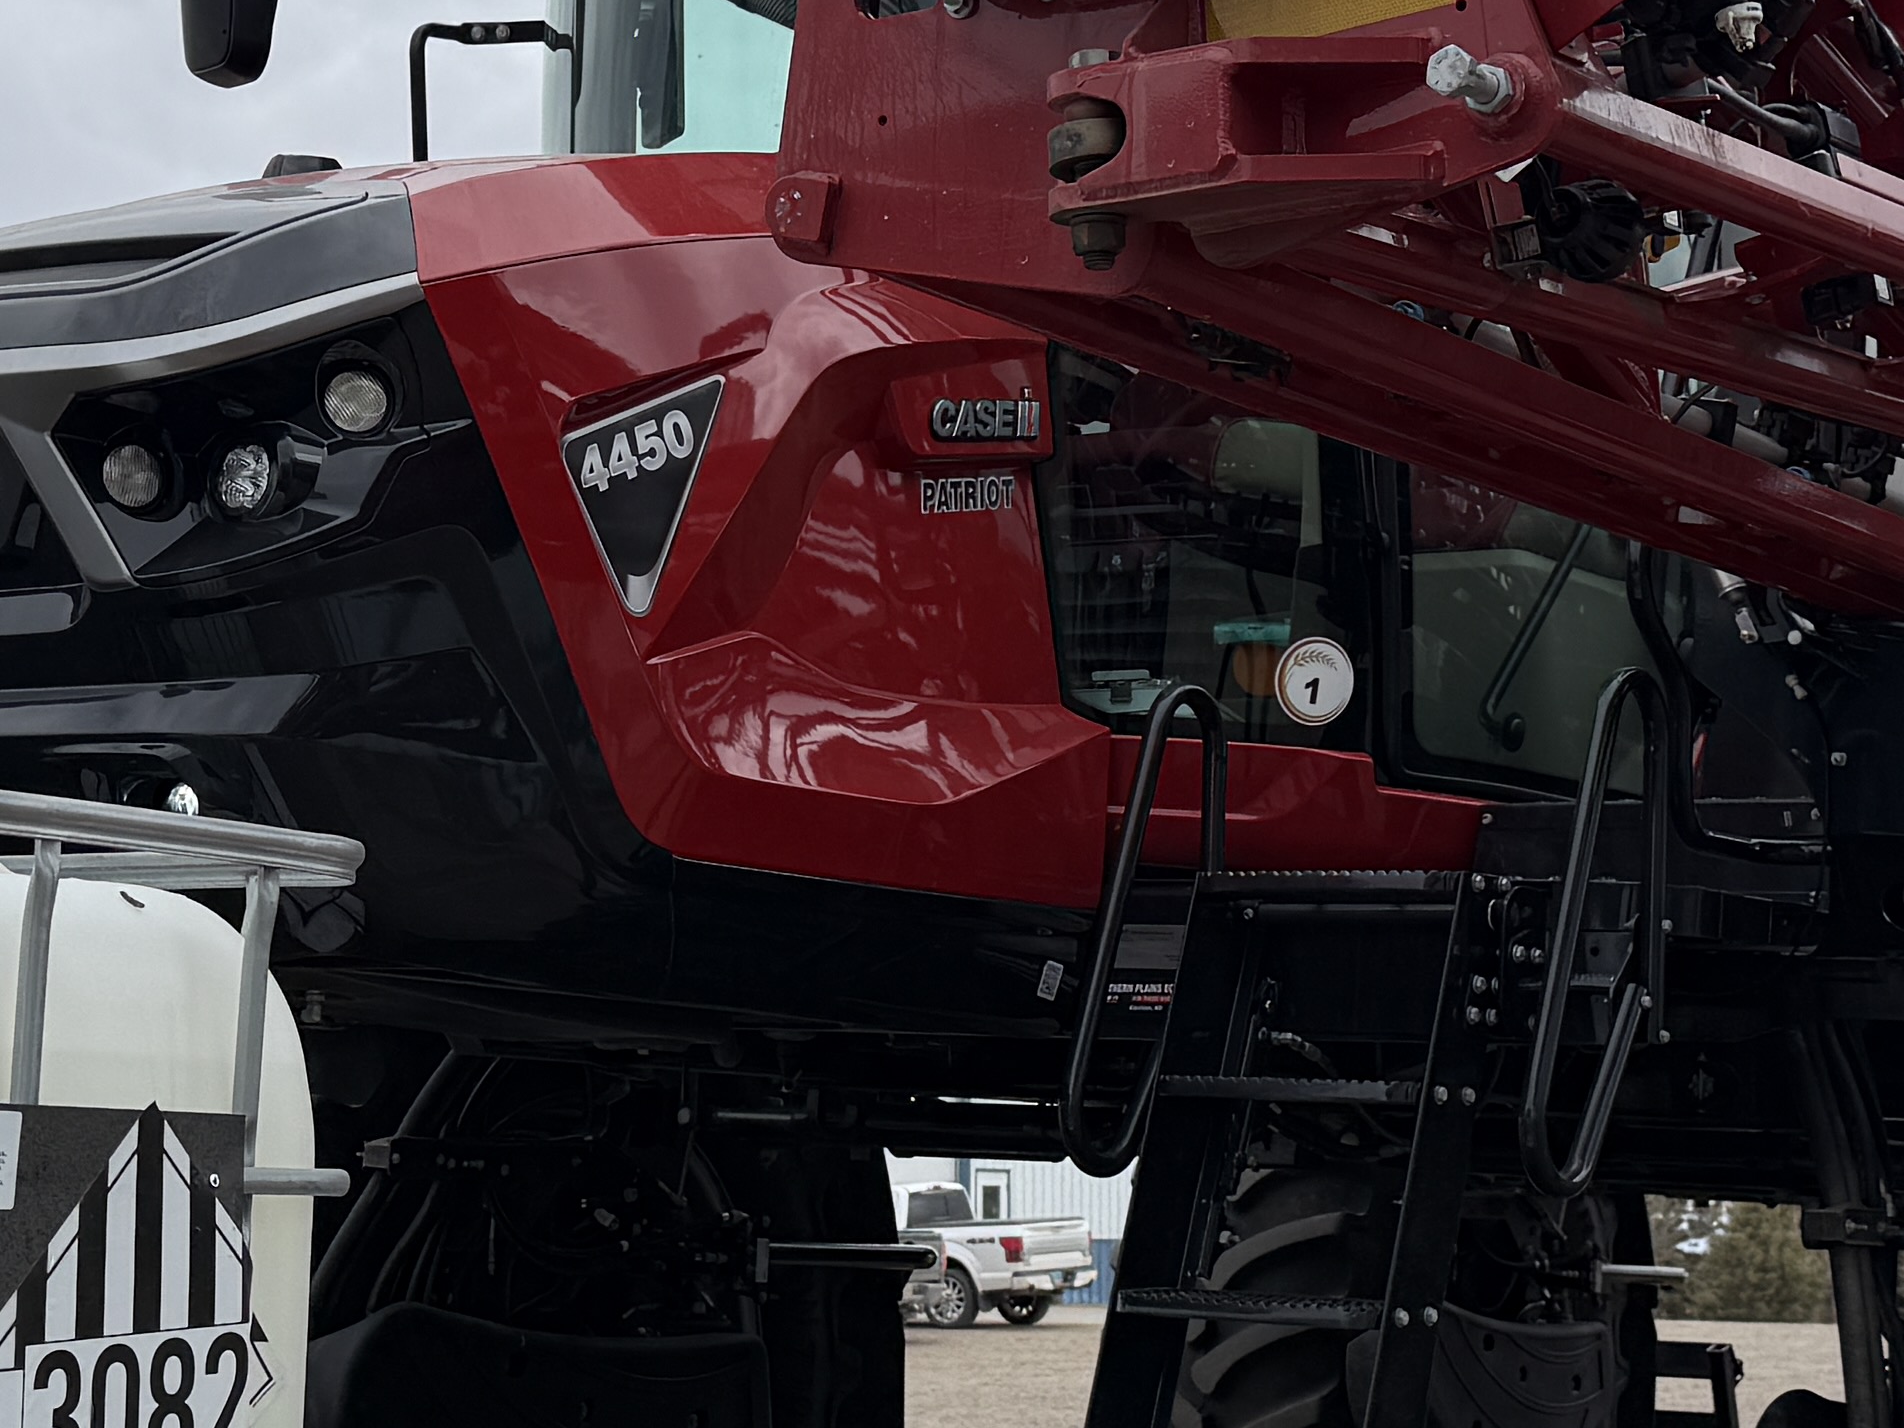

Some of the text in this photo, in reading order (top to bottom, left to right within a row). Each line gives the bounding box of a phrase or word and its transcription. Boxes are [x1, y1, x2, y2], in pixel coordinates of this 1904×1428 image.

[932, 398, 1015, 438] CASE
[581, 409, 695, 492] 4450
[919, 476, 1015, 514] PATRIOT
[1304, 677, 1320, 705] 1
